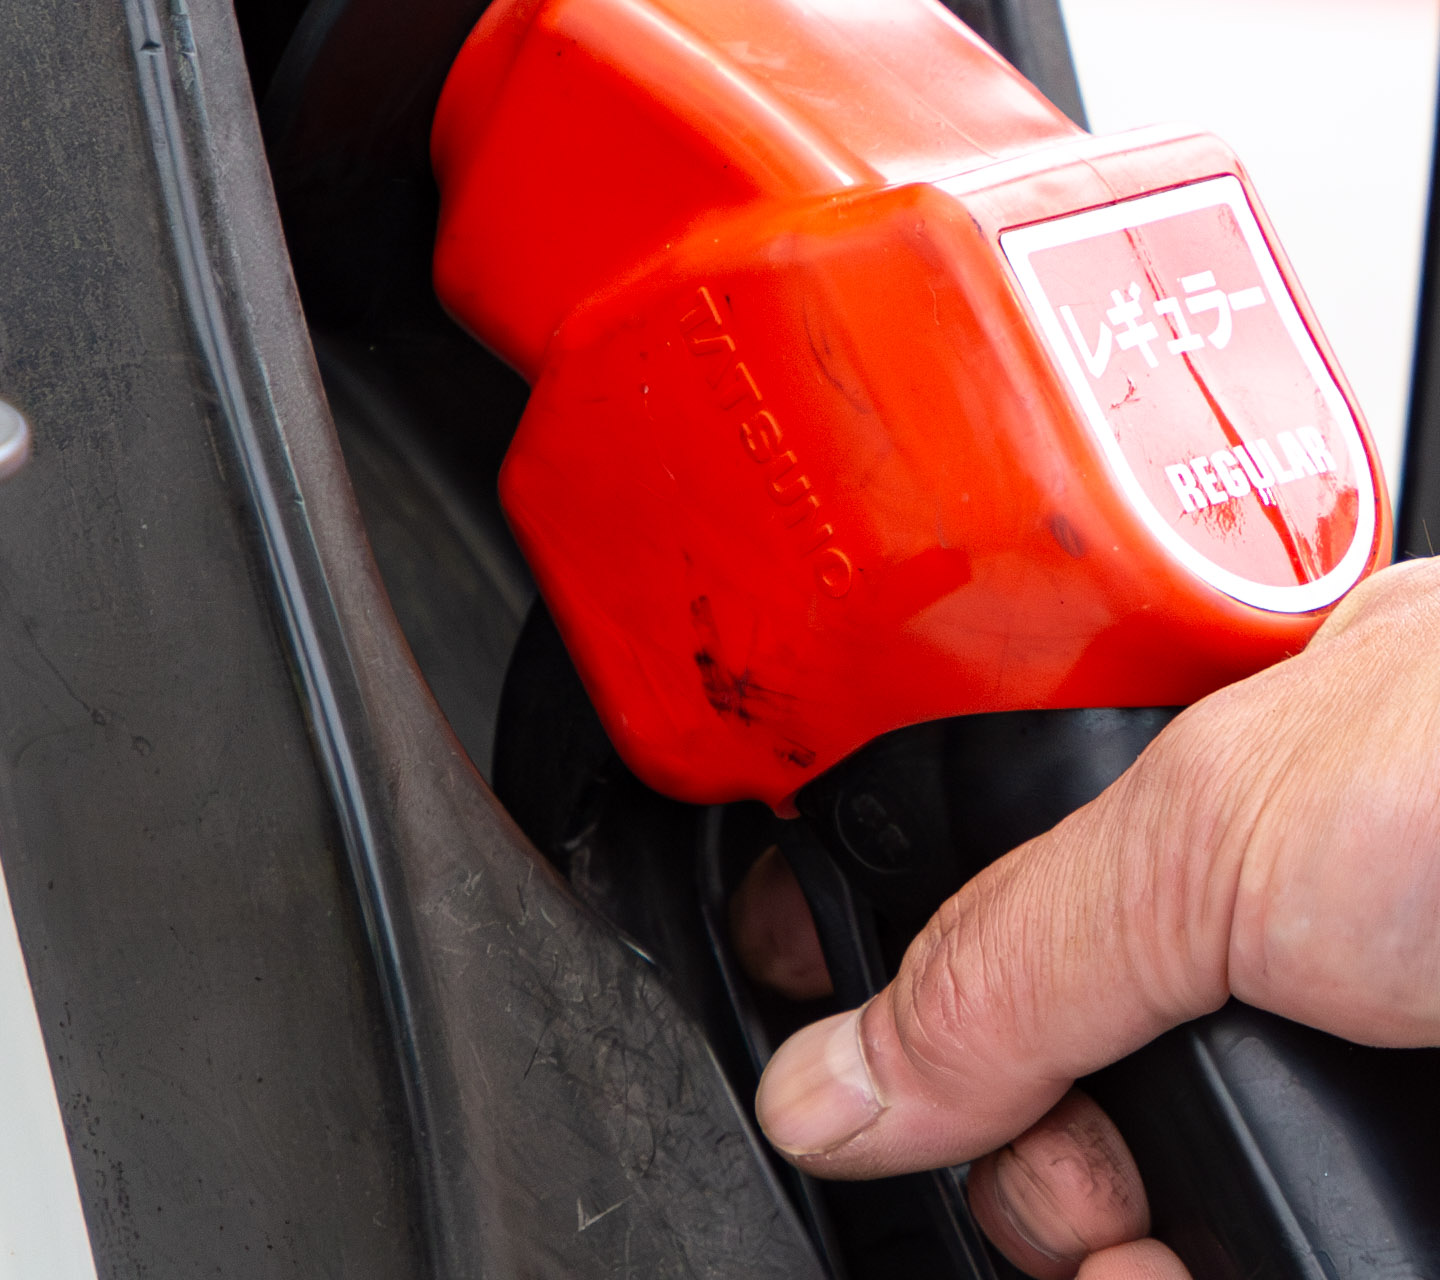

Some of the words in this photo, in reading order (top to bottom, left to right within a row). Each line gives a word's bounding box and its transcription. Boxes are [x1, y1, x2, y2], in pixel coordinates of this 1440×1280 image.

[1059, 270, 1266, 378] レギュラー
[1164, 425, 1339, 515] REGULAR
